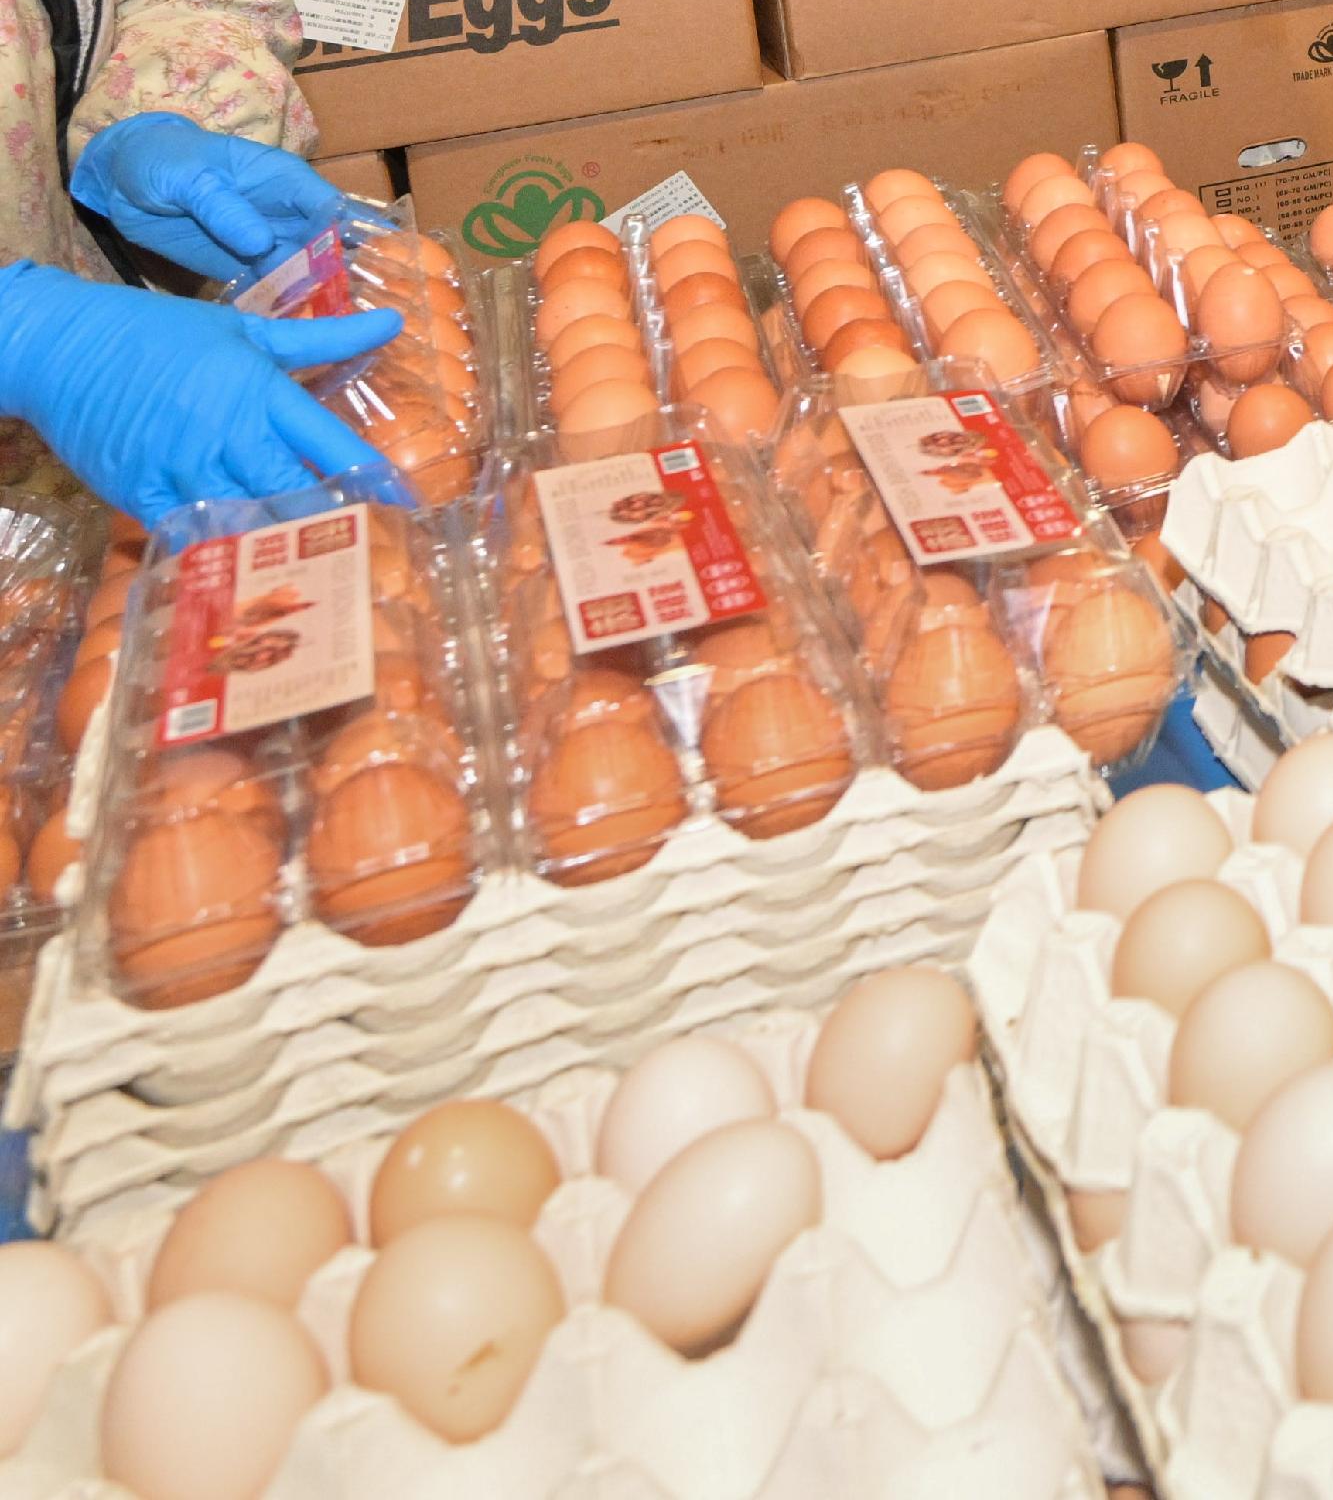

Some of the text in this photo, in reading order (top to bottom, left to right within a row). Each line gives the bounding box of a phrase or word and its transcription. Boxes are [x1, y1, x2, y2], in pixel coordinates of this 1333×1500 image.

[1292, 70, 1313, 82] TRADE
[1314, 67, 1333, 79] MARK
[1160, 87, 1221, 105] FRAGILE
[524, 154, 553, 165] Fresh
